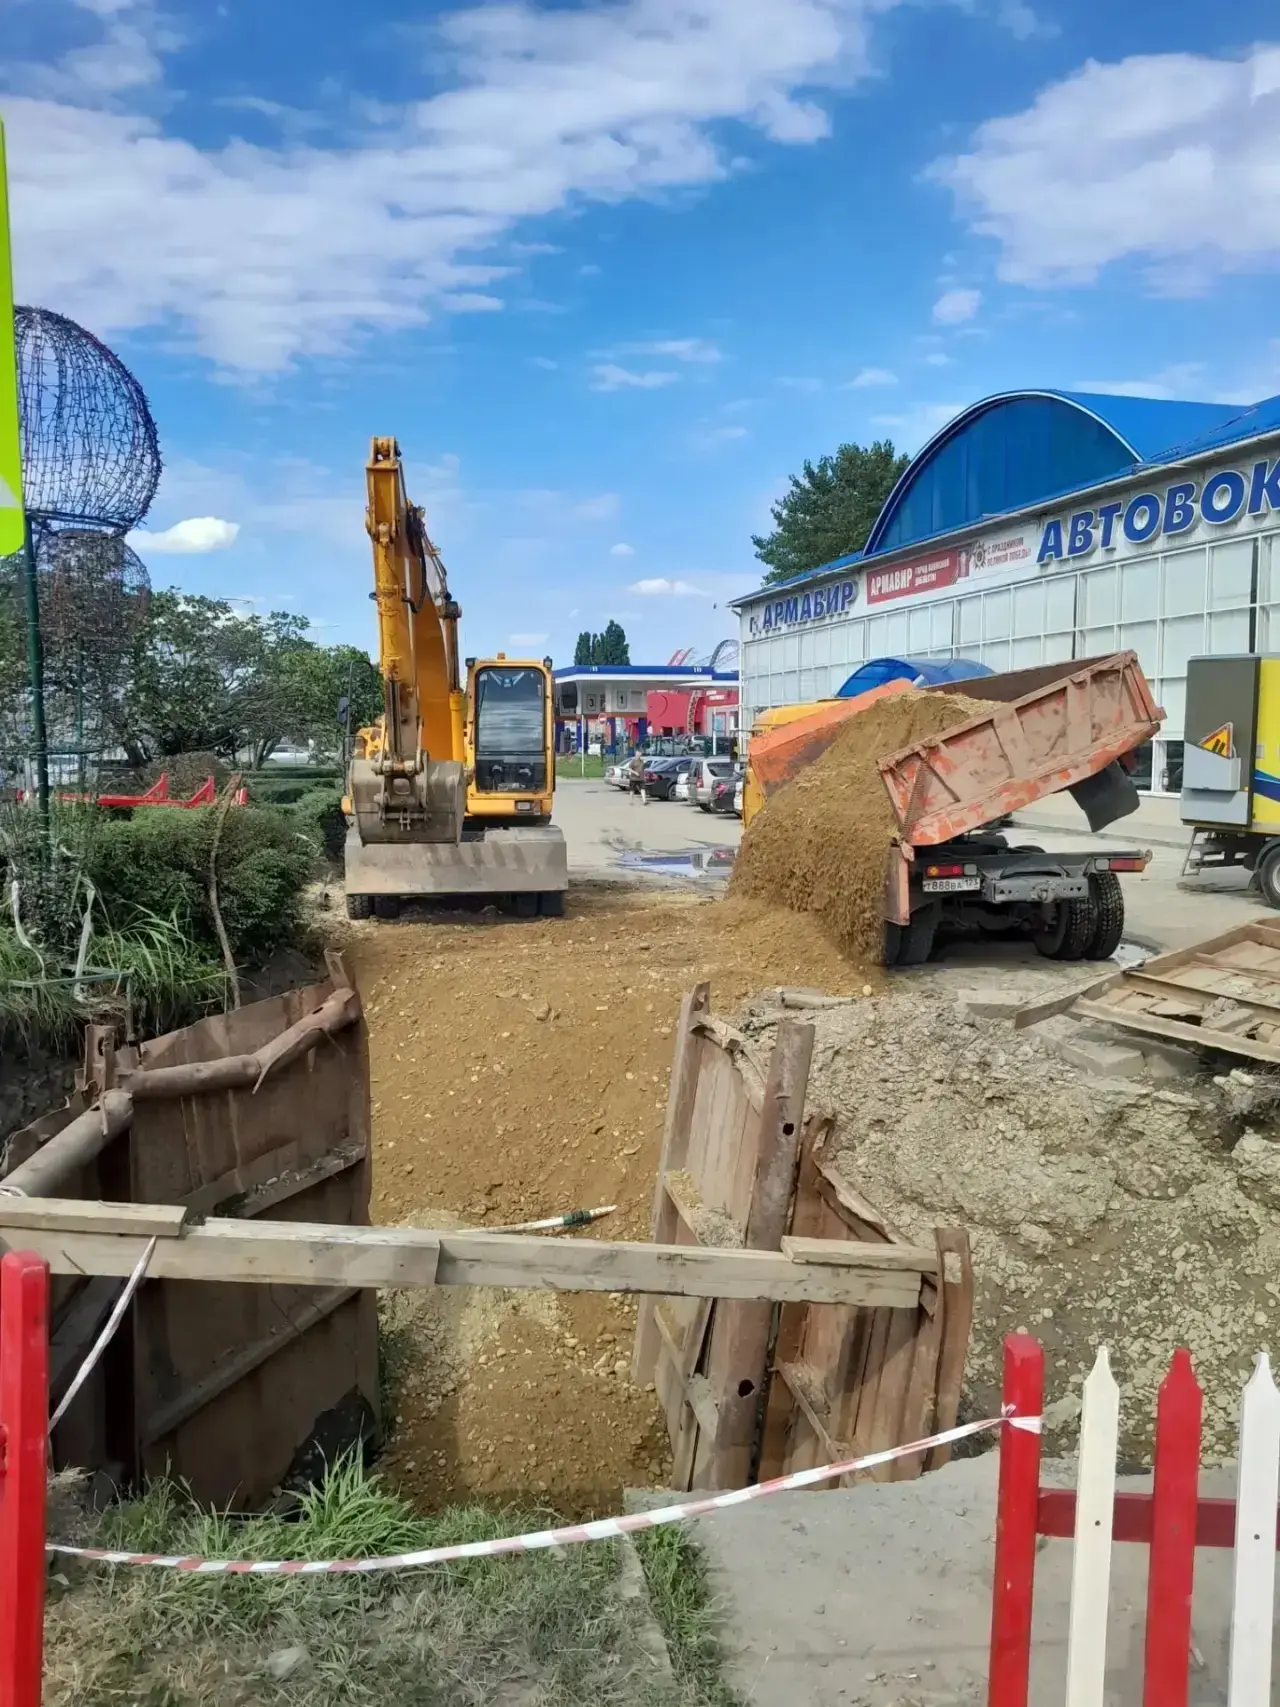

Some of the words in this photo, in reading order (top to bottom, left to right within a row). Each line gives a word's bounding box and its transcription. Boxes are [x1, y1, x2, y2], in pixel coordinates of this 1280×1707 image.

[1036, 457, 1280, 564] АВТОВОК
[762, 581, 854, 629] АРМАВИР
[870, 567, 913, 597] АРМАВИР
